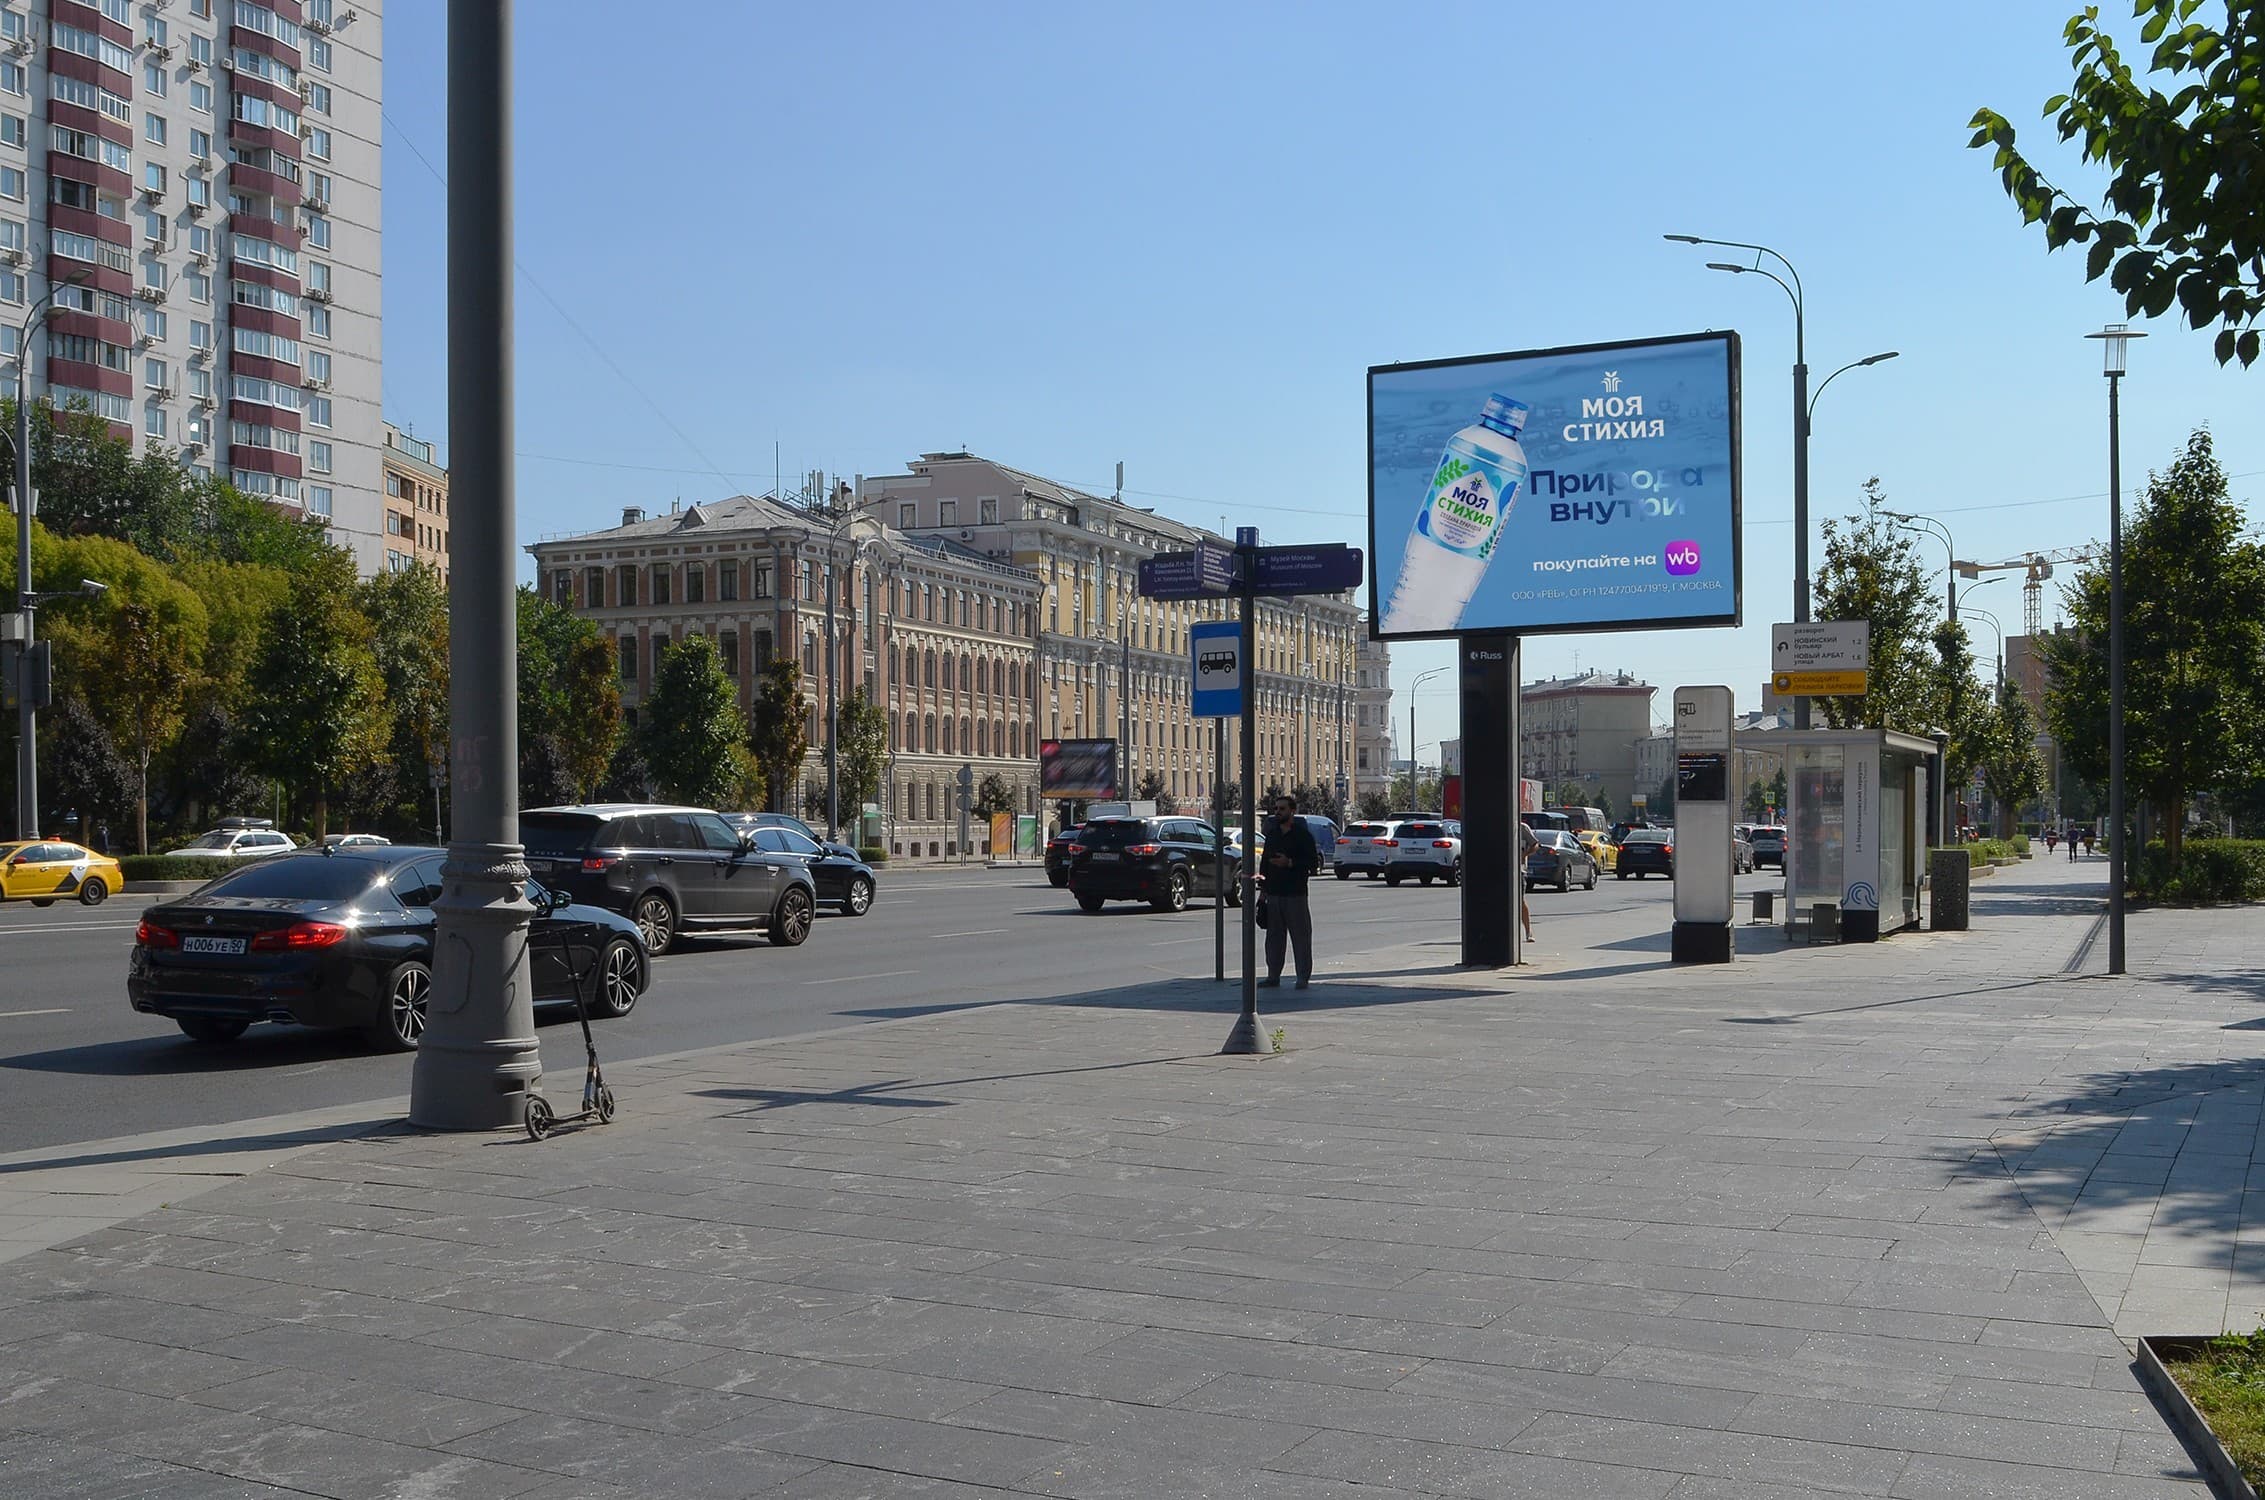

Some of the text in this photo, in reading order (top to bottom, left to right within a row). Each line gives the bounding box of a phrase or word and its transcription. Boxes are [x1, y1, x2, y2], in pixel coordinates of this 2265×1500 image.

[1582, 395, 1643, 419] МОЯ
[1562, 418, 1665, 442] СТИХИЯ
[1530, 467, 1703, 498] Природа
[1452, 486, 1489, 511] МОЯ
[1437, 496, 1494, 527] СТИХИЯ
[1550, 497, 1686, 525] внутри
[1533, 554, 1657, 572] покупайте на
[1667, 548, 1698, 565] wb
[1511, 590, 1534, 600] ООО
[1569, 587, 1596, 597] ОГРН
[1480, 651, 1503, 660] Russ
